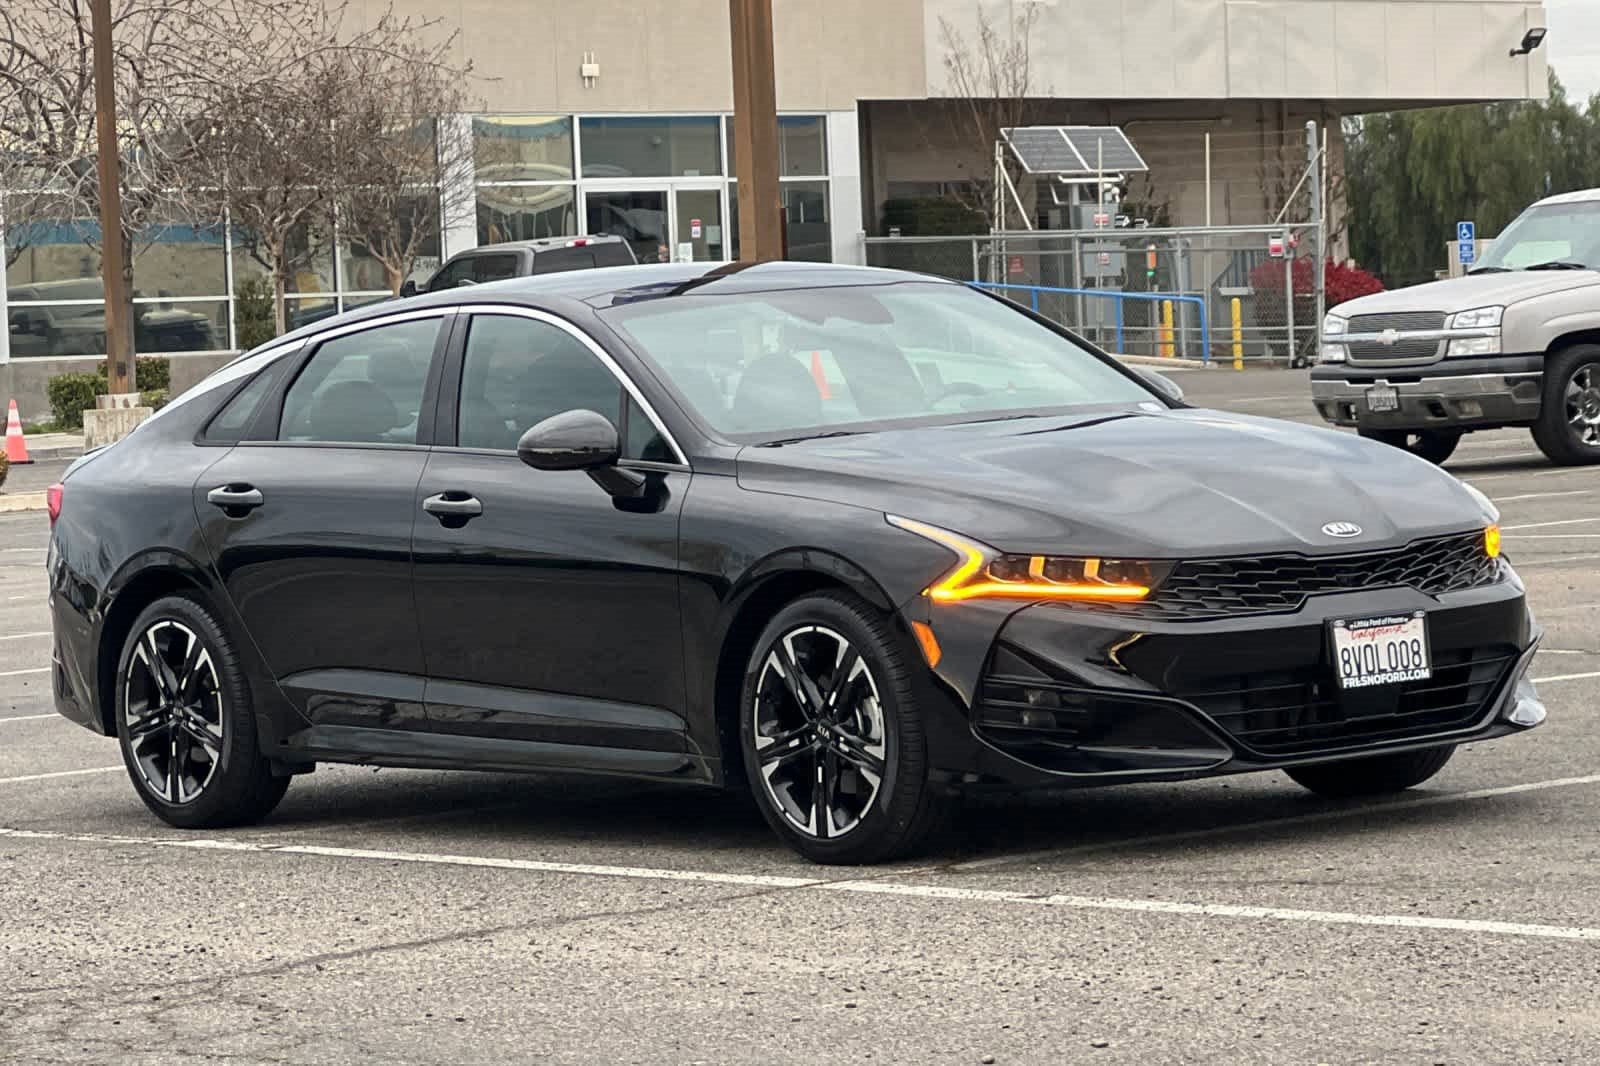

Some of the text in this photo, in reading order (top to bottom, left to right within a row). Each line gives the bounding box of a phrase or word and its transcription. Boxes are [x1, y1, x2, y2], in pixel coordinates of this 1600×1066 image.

[1326, 522, 1359, 535] KIA
[1351, 625, 1408, 641] California
[1343, 668, 1430, 688] FRESNOFORD.COM
